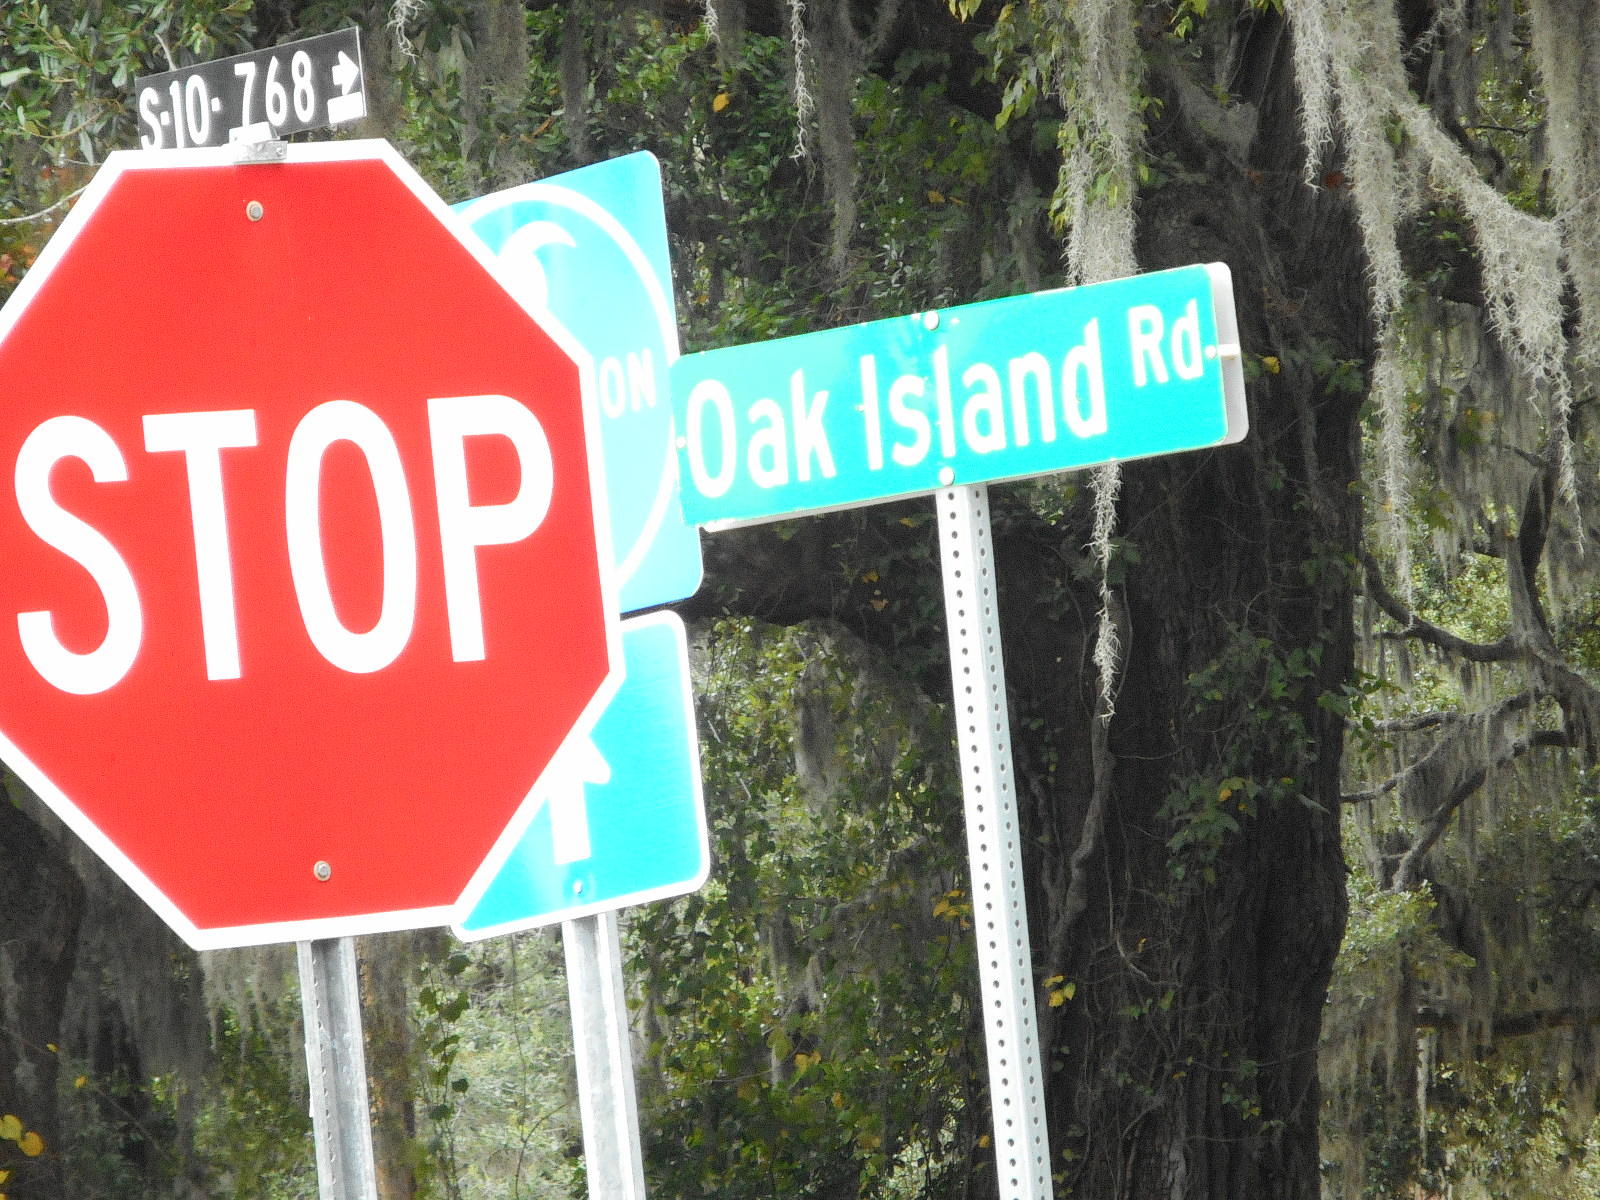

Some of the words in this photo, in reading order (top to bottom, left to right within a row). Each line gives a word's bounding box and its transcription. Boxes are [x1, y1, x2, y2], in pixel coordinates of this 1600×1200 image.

[686, 367, 838, 498] Oak
[860, 317, 1108, 471] Island
[1128, 298, 1205, 387] Rd
[14, 393, 555, 696] STOP
